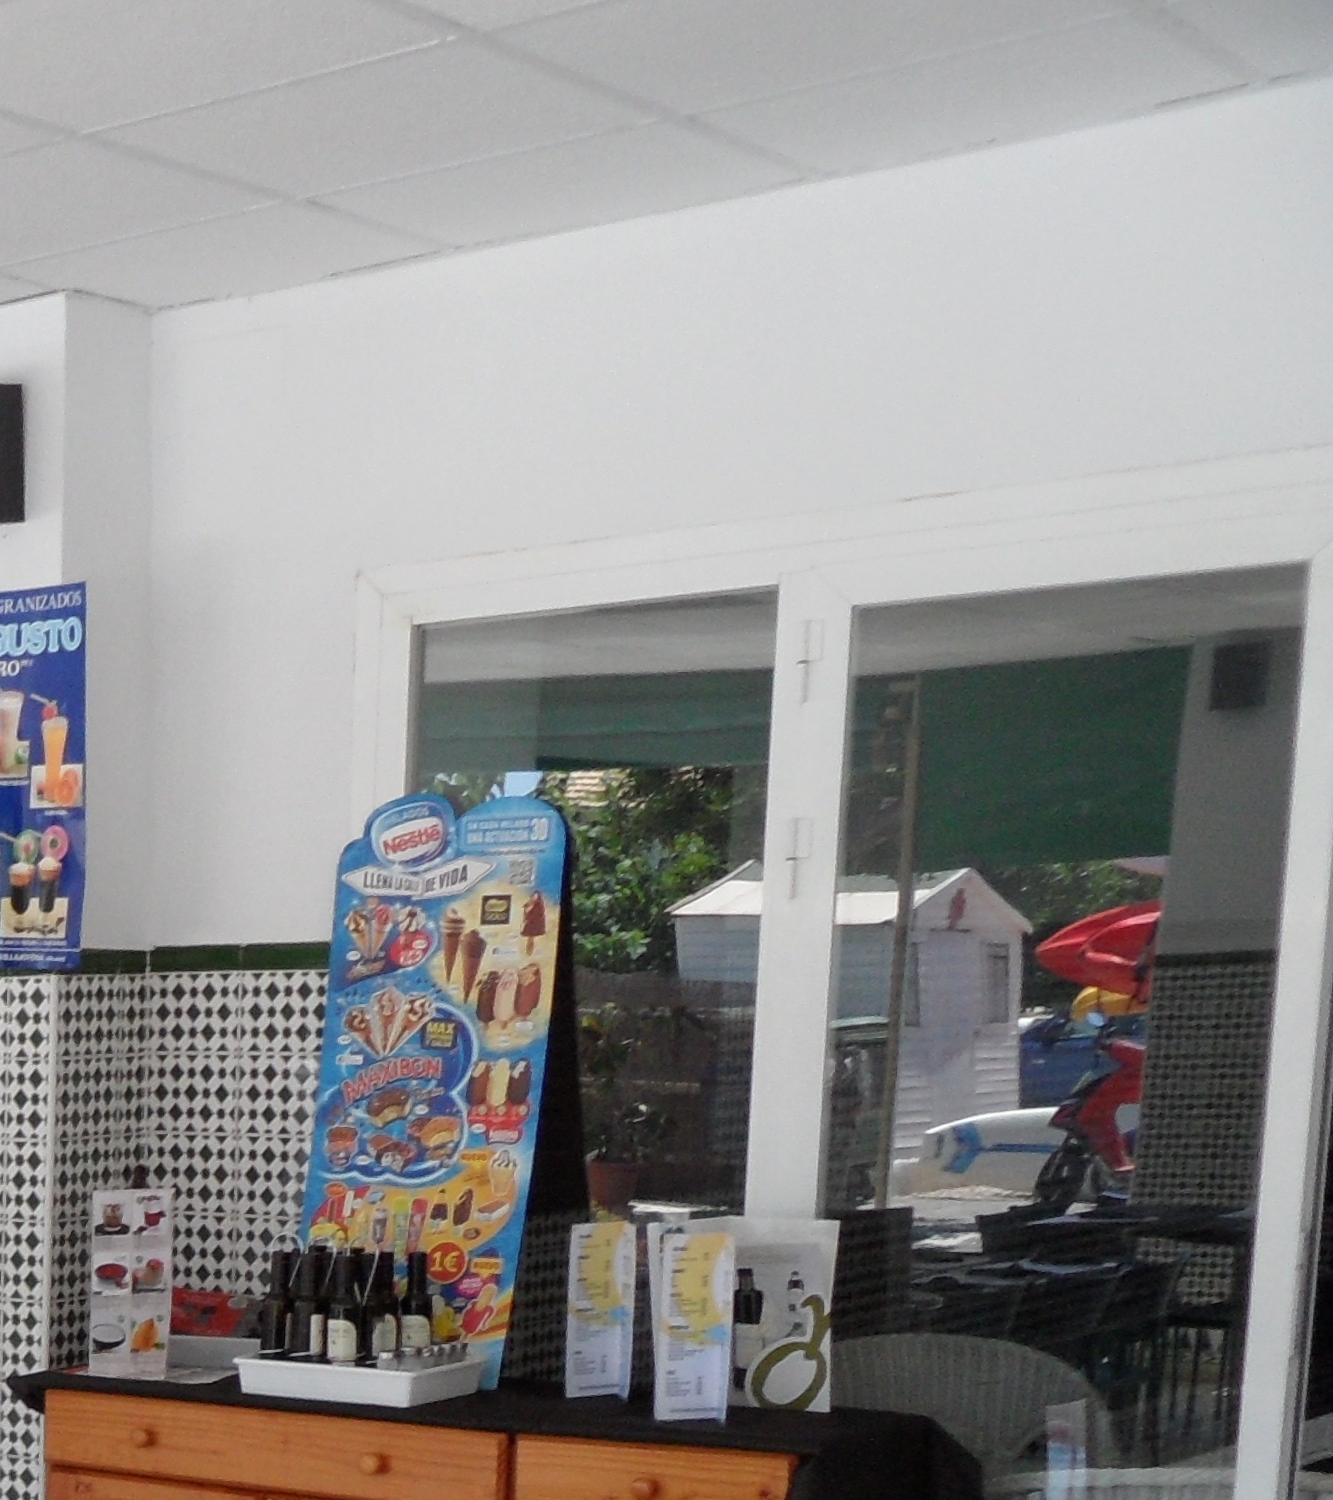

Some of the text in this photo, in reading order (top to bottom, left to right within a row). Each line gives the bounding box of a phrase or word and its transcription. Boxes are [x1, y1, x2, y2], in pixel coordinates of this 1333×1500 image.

[439, 863, 468, 889] VIDA
[426, 1021, 455, 1035] MAX
[343, 1056, 443, 1104] MAXIBON
[432, 1251, 460, 1272] 1€
